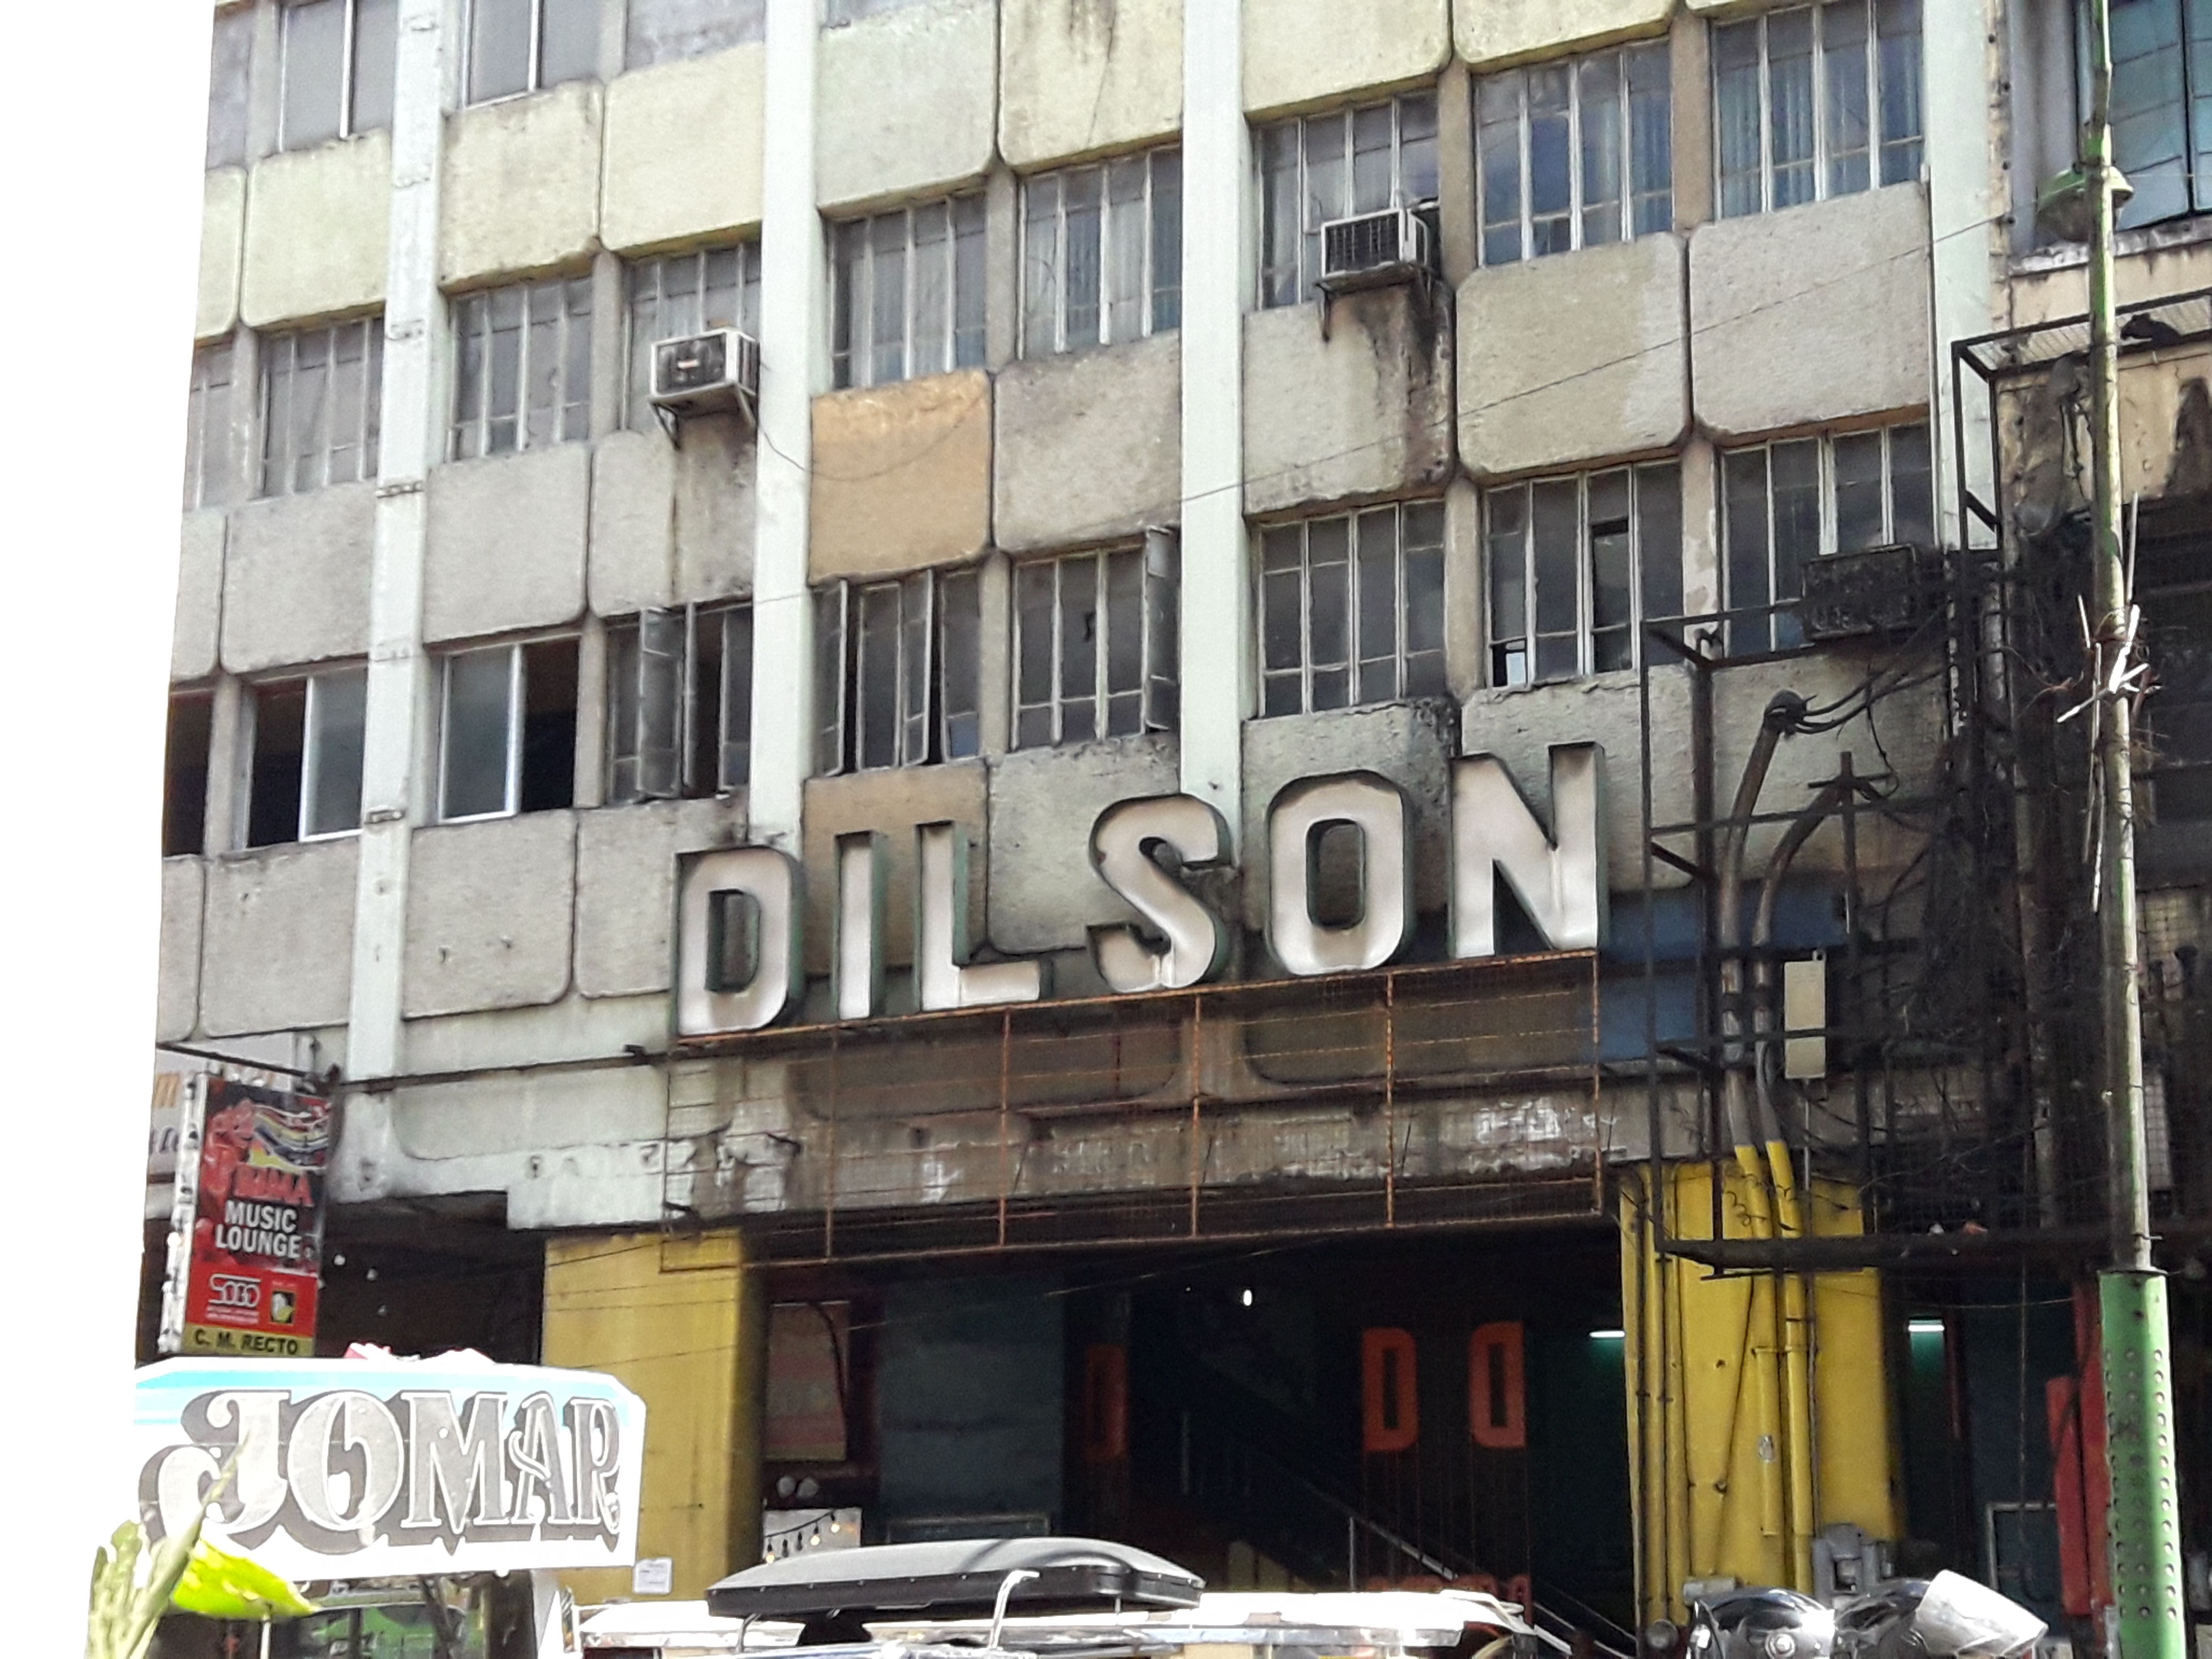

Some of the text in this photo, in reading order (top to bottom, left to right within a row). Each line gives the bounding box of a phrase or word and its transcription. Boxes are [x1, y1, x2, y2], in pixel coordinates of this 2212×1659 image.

[676, 742, 1607, 1037] DILSON
[225, 1200, 298, 1233] MUSIC
[215, 1223, 302, 1258] LOUNGE
[241, 1334, 298, 1355] RECTO
[139, 1389, 620, 1553] JOMAR
